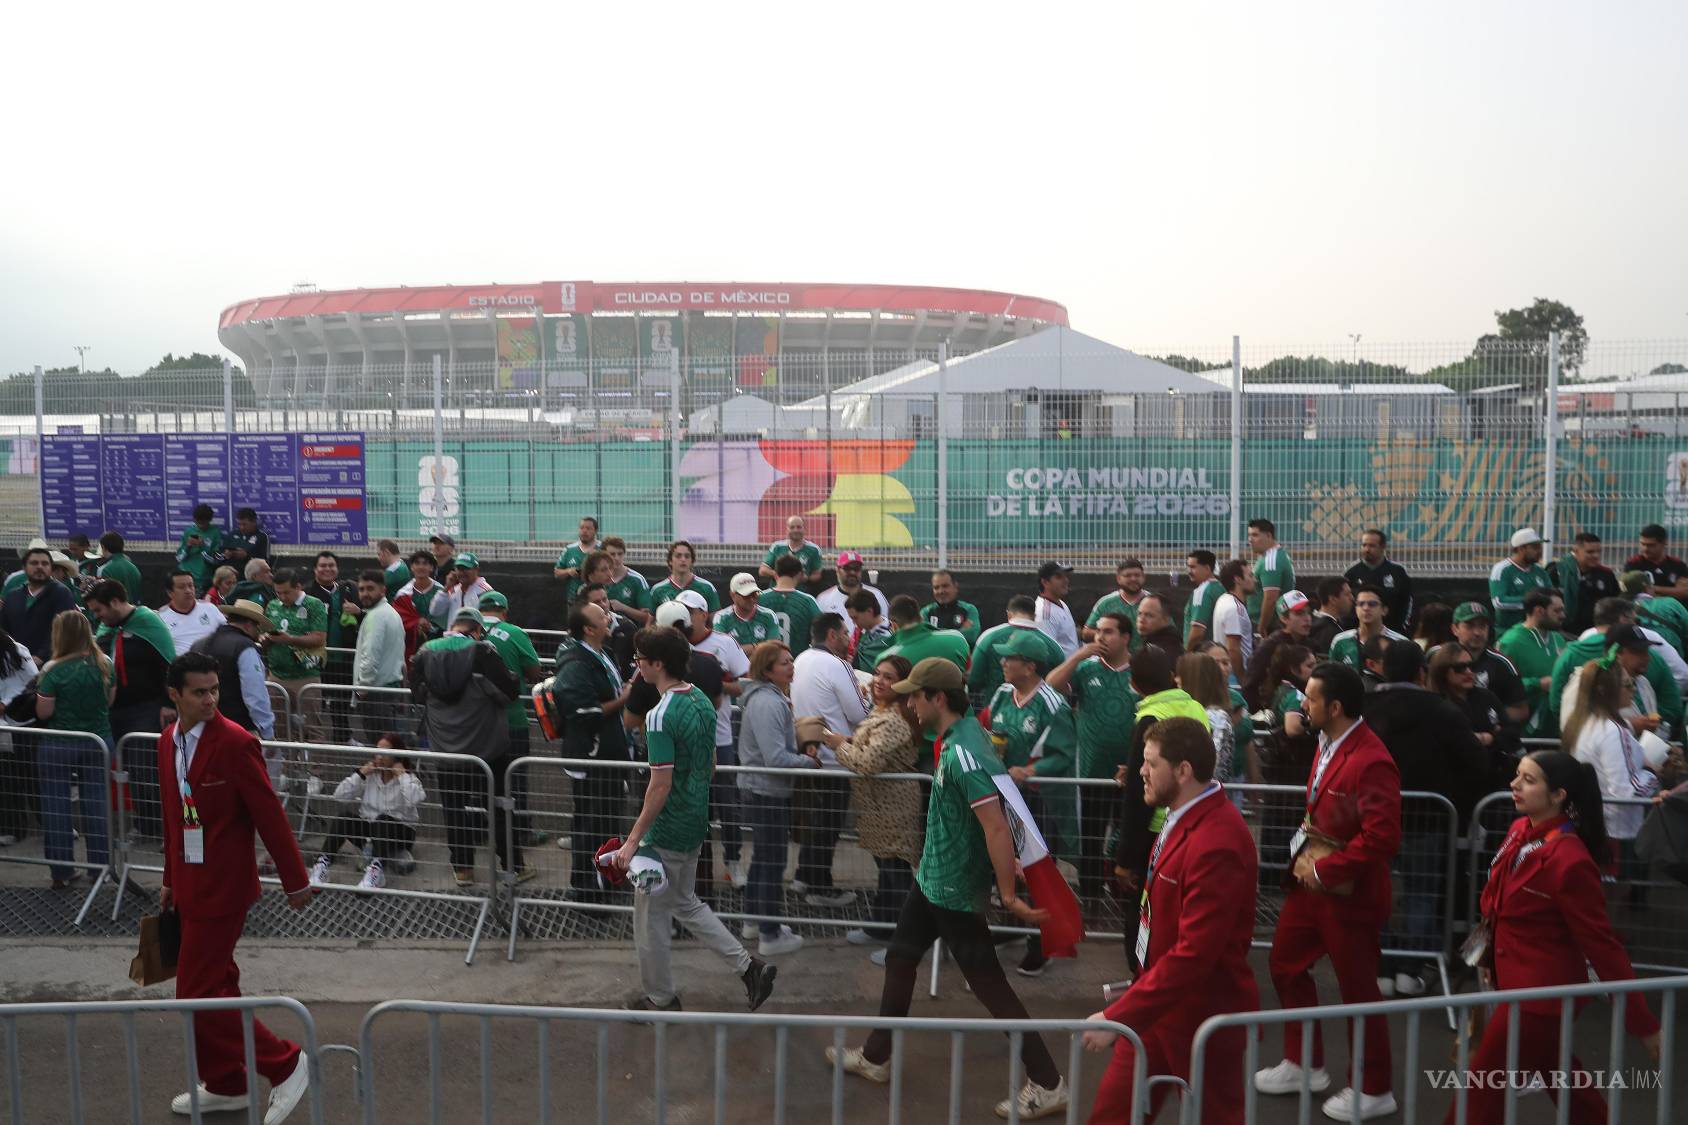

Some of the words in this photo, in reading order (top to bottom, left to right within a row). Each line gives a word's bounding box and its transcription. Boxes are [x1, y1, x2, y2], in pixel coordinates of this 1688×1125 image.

[469, 295, 535, 305] ESTADIO
[615, 292, 682, 304] CIUDAD
[690, 292, 714, 304] DE
[721, 290, 790, 304] MÉXICO
[1006, 467, 1082, 489] COPA
[1088, 467, 1213, 489] MUNDIAL
[986, 495, 1022, 516] DE
[1028, 495, 1064, 516] LA
[1069, 495, 1129, 516] FIFA
[1134, 495, 1231, 516] 2026
